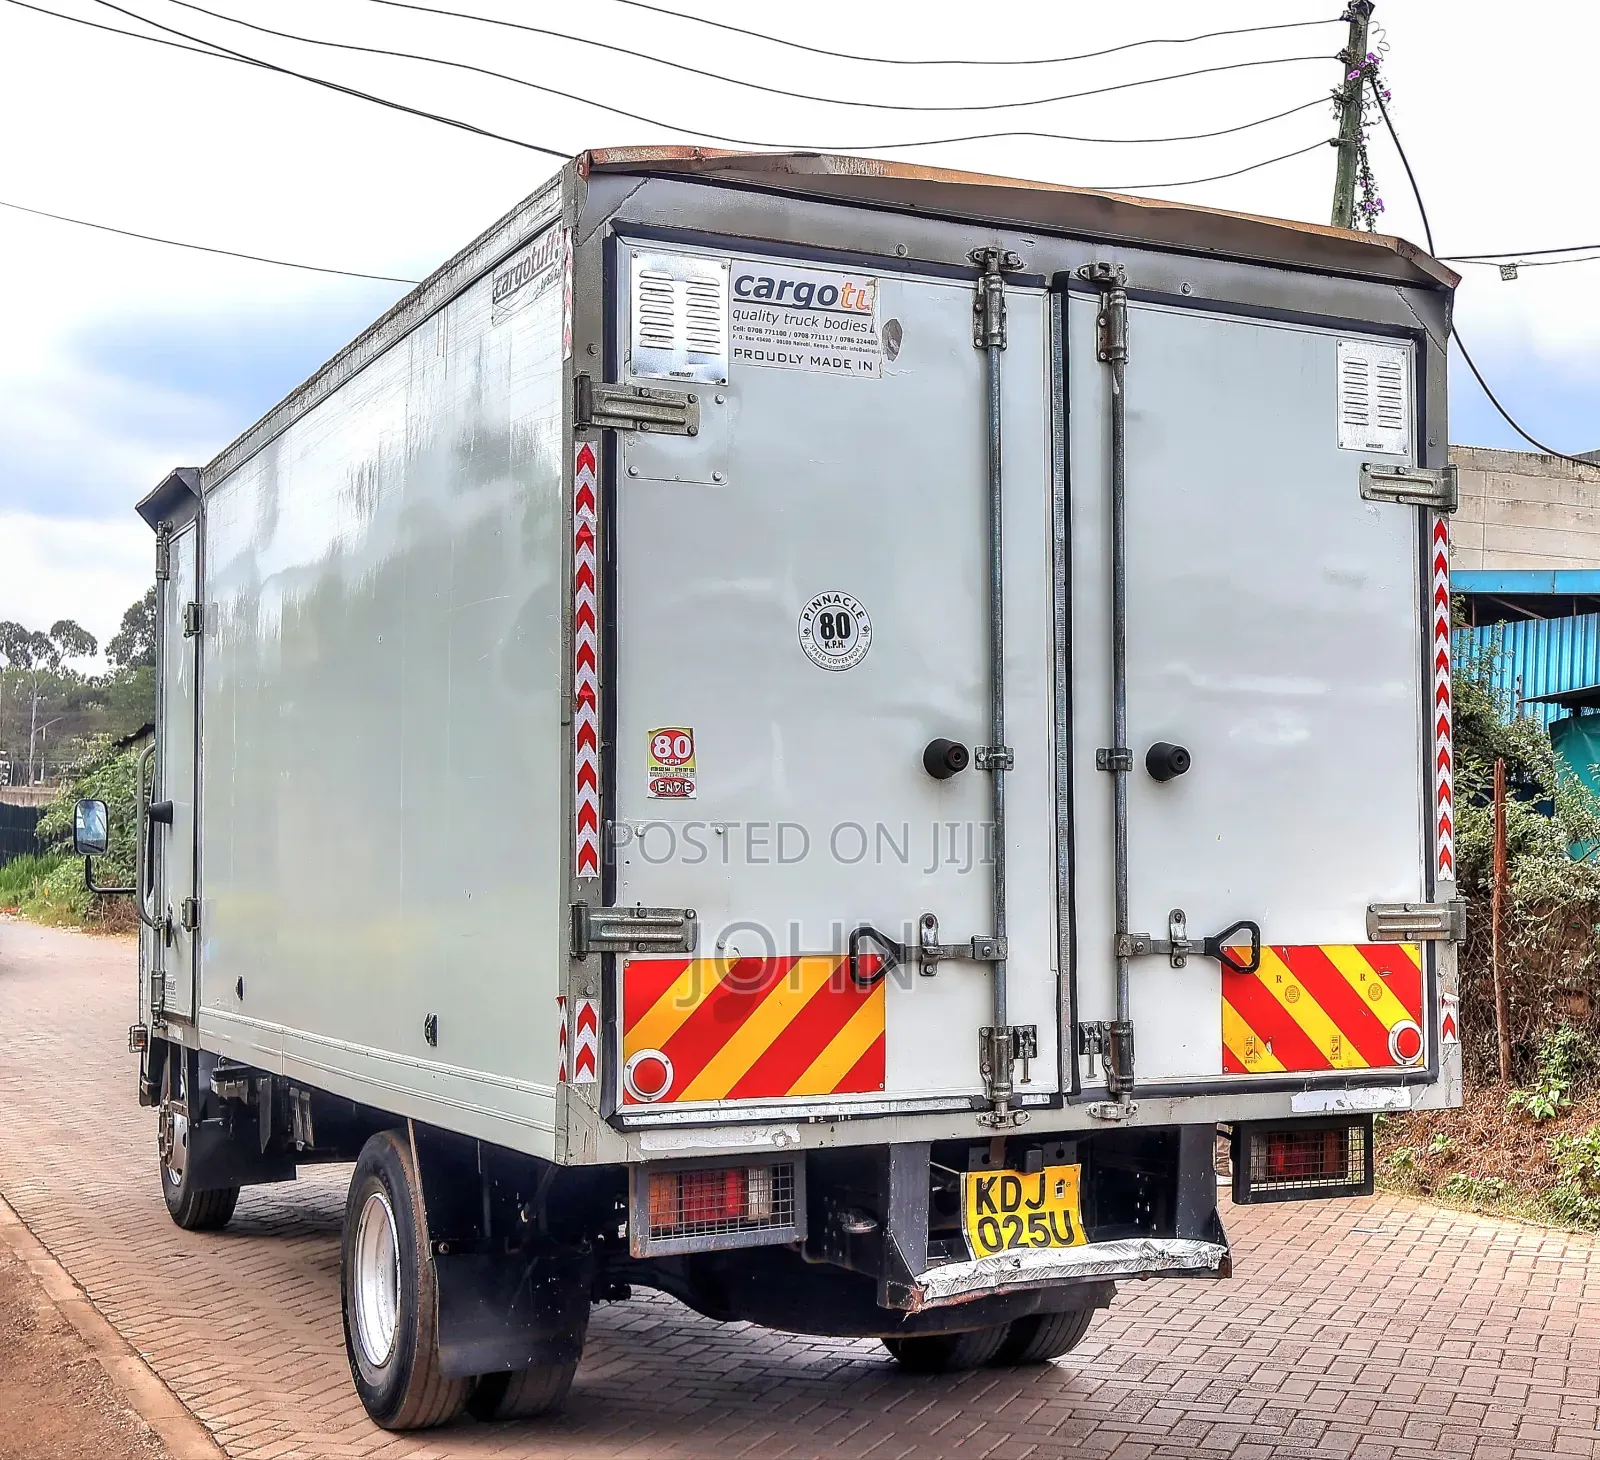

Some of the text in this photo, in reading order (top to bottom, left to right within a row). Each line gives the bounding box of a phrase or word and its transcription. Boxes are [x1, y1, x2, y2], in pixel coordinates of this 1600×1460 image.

[732, 309, 868, 333] quality truck bodies
[747, 326, 763, 334] 0708
[793, 331, 809, 339] 0708
[810, 333, 833, 341] 771117
[734, 348, 873, 371] PROUDLY MADE IN
[803, 593, 865, 621] PINNACLE
[819, 611, 851, 640] 80
[810, 645, 827, 662] SPEED
[827, 644, 863, 665] GOVERNORS
[824, 640, 846, 649] K.P.H.
[653, 735, 692, 759] 80
[1275, 974, 1283, 983] R
[1359, 973, 1366, 981] R
[976, 1173, 1046, 1216] KDJ
[977, 1209, 1075, 1253] 025U
